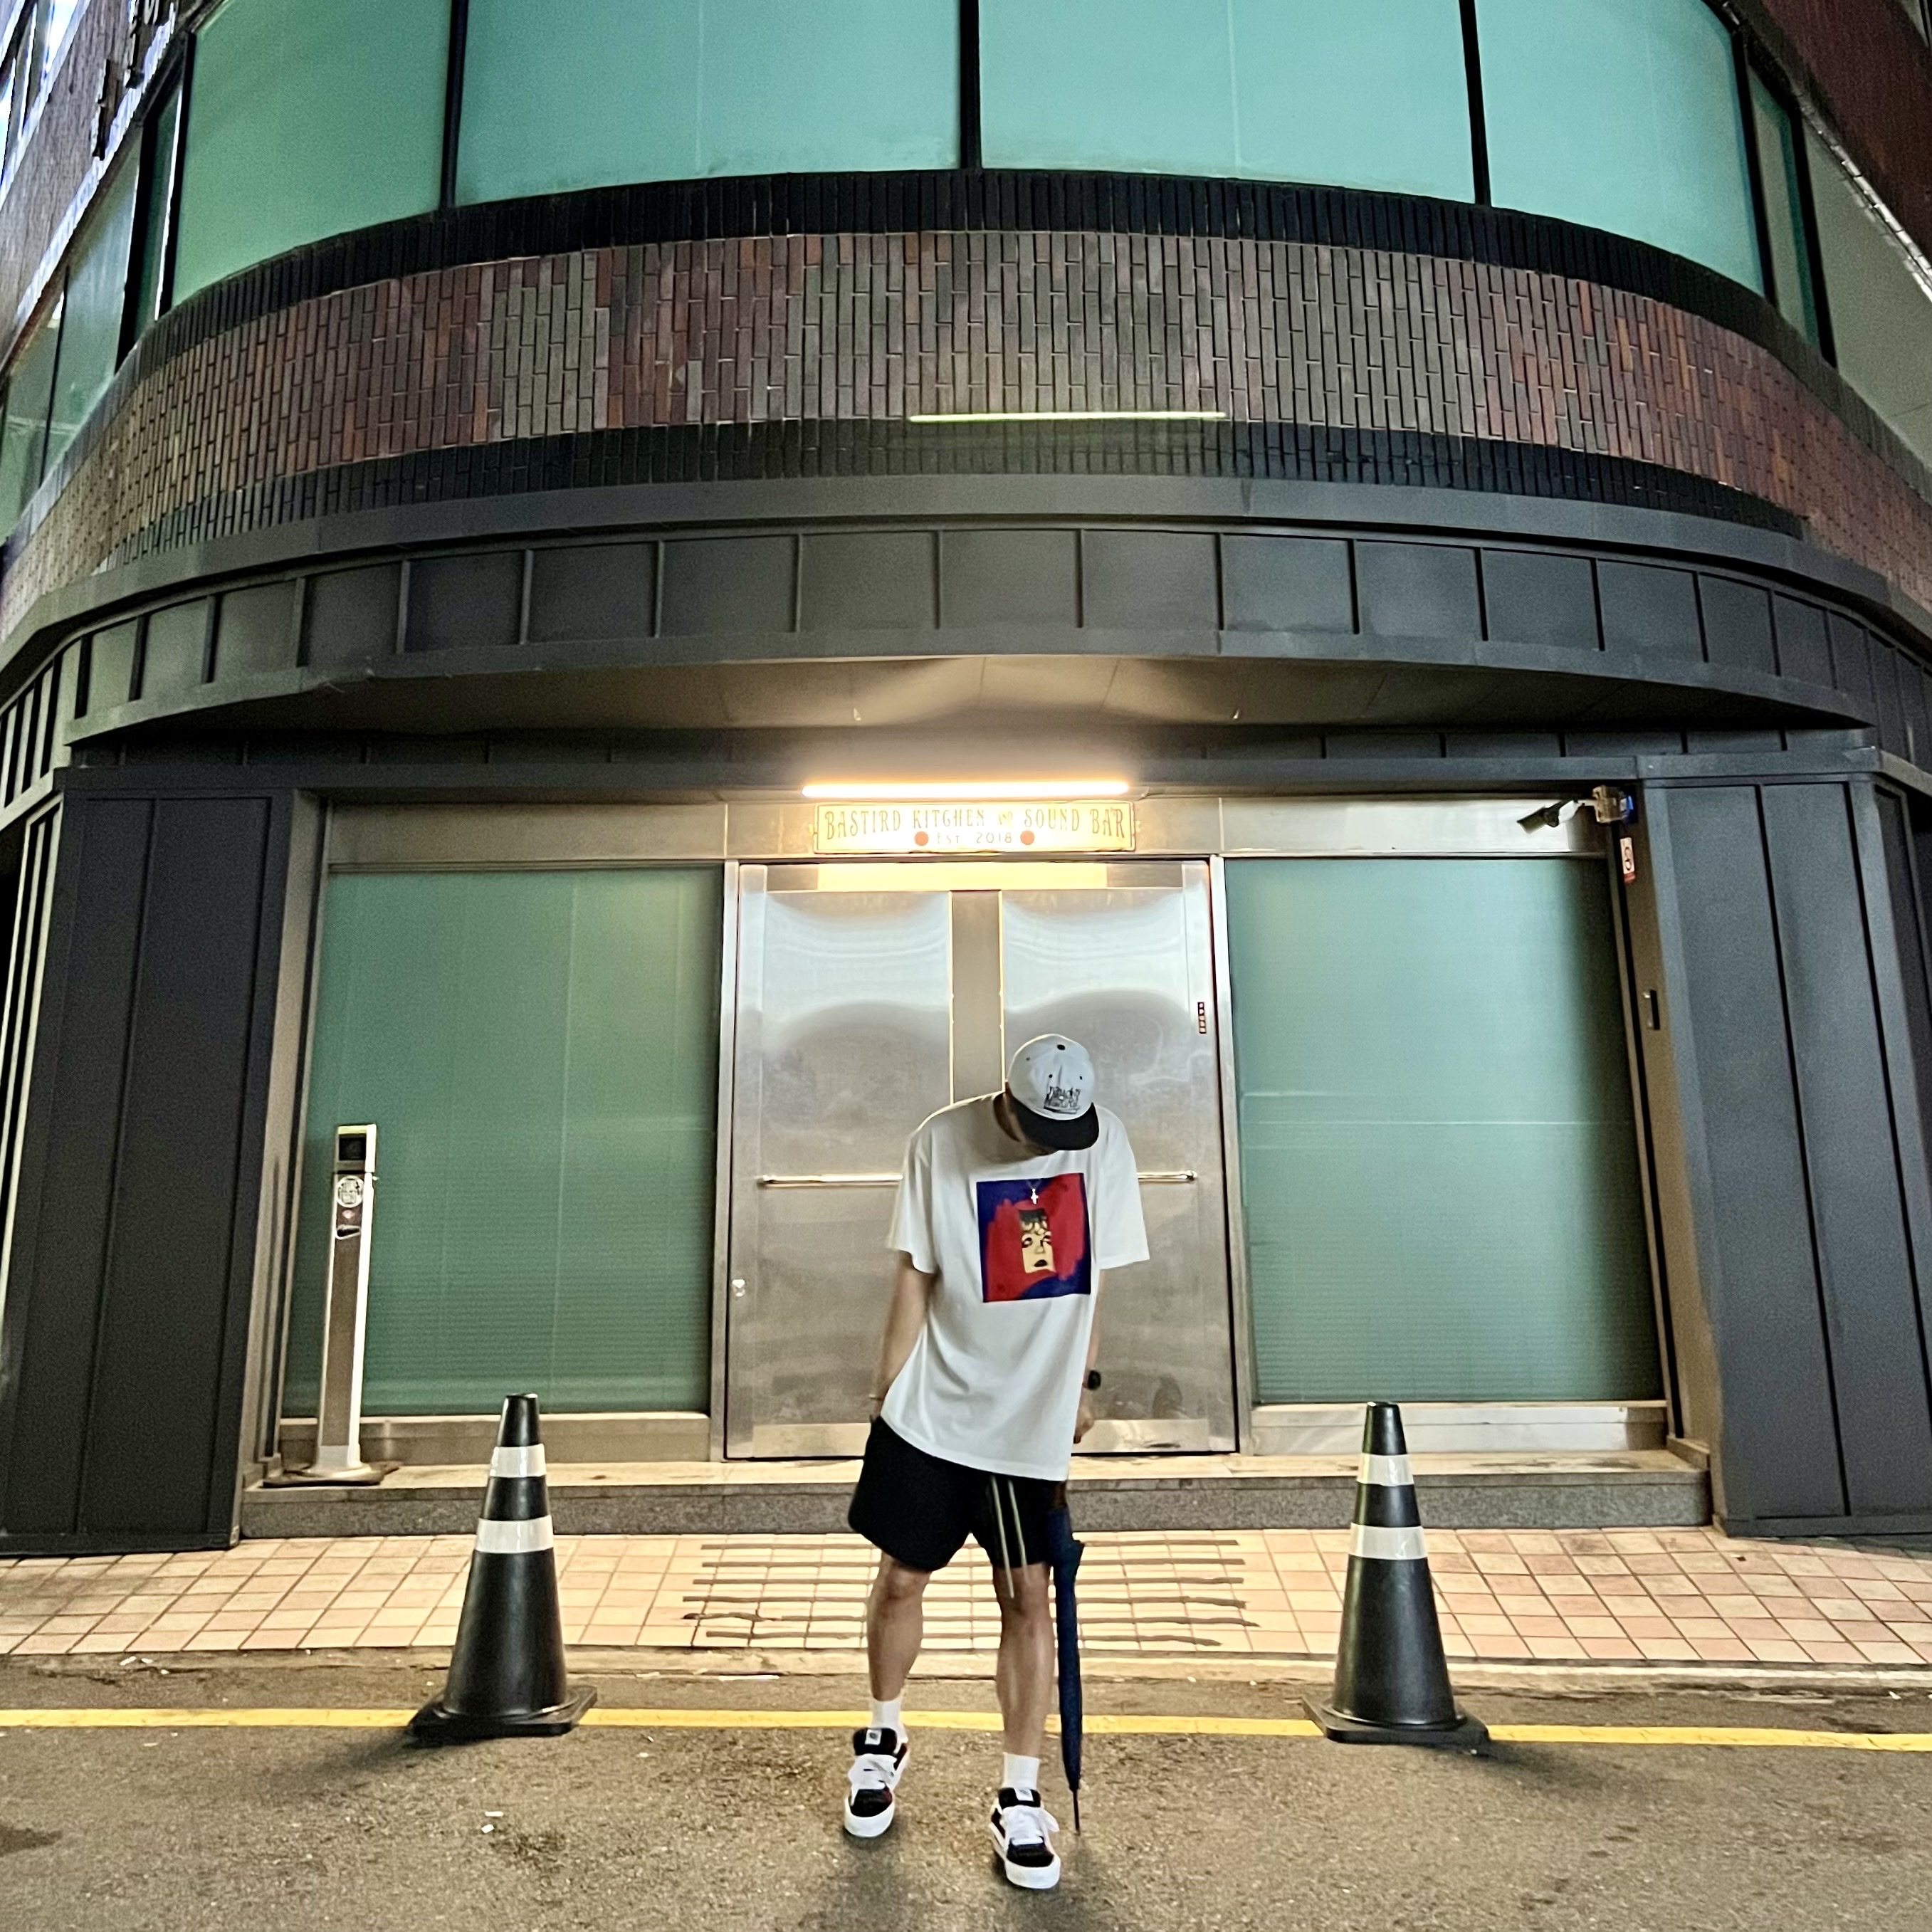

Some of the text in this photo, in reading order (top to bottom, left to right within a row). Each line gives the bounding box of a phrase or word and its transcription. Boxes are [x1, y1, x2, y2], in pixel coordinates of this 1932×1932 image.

[825, 809, 901, 840] BASTIRD
[913, 809, 985, 829] KITCHEN
[1024, 809, 1080, 831] SOUND
[1090, 807, 1125, 838] BAR
[977, 832, 1012, 844] 2018
